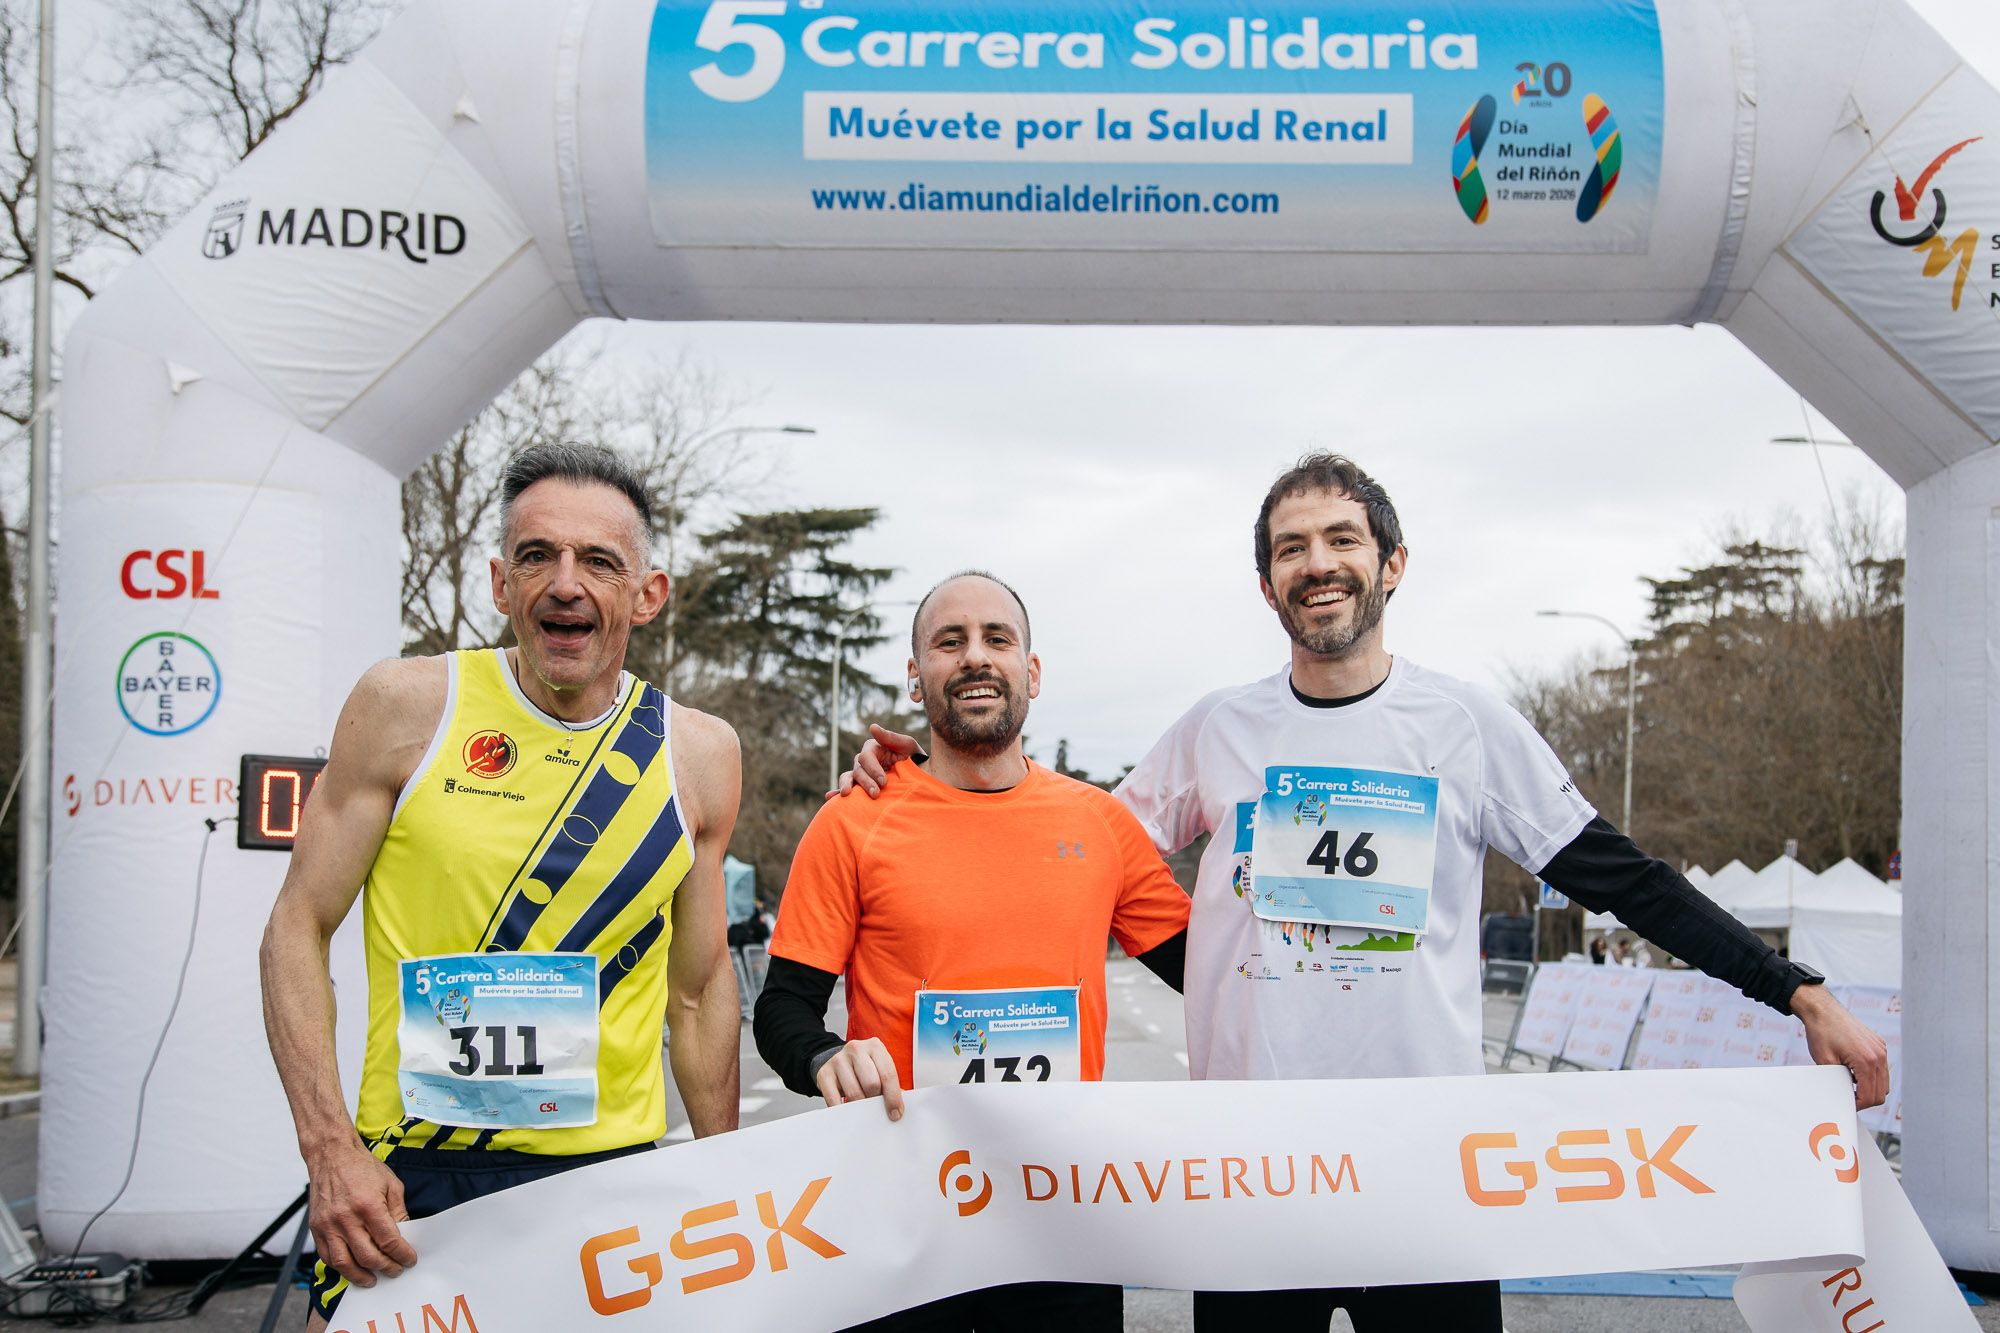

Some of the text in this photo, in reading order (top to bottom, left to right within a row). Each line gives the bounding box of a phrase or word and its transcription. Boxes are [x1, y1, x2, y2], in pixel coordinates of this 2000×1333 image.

[801, 16, 1104, 68] Carrera
[1130, 17, 1479, 70] Solidaria
[1512, 62, 1572, 104] 20
[829, 106, 1387, 148] Muévete por la Salud Renal
[1500, 120, 1528, 135] Día
[1498, 143, 1571, 158] Mundial
[1497, 166, 1580, 181] del Riñón
[813, 182, 1280, 214] www.diamundialdelriñon.com
[1497, 189, 1576, 201] 12 marzo 2026
[258, 207, 467, 264] MADRID
[120, 549, 220, 600] CSL
[125, 677, 211, 692] BAYER
[159, 641, 175, 727] BAYER
[544, 753, 580, 767] amura
[457, 785, 526, 802] Colmenar Viejo
[1297, 778, 1347, 792] Carrera
[1351, 780, 1410, 798] Solidaria
[1307, 830, 1379, 878] 46
[1379, 904, 1396, 915] CSL
[436, 971, 493, 986] Carrera
[497, 968, 564, 983] Solidaria
[479, 987, 511, 995] Muévete
[536, 987, 557, 995] Salud
[953, 1005, 1004, 1018] Carrera
[1007, 1003, 1057, 1017] Solidaria
[449, 1025, 544, 1076] 311
[539, 1102, 558, 1113] CSL
[579, 1176, 848, 1317] GSK
[1021, 1153, 1362, 1204] DIAVERUM
[1459, 1124, 1717, 1207] GSK
